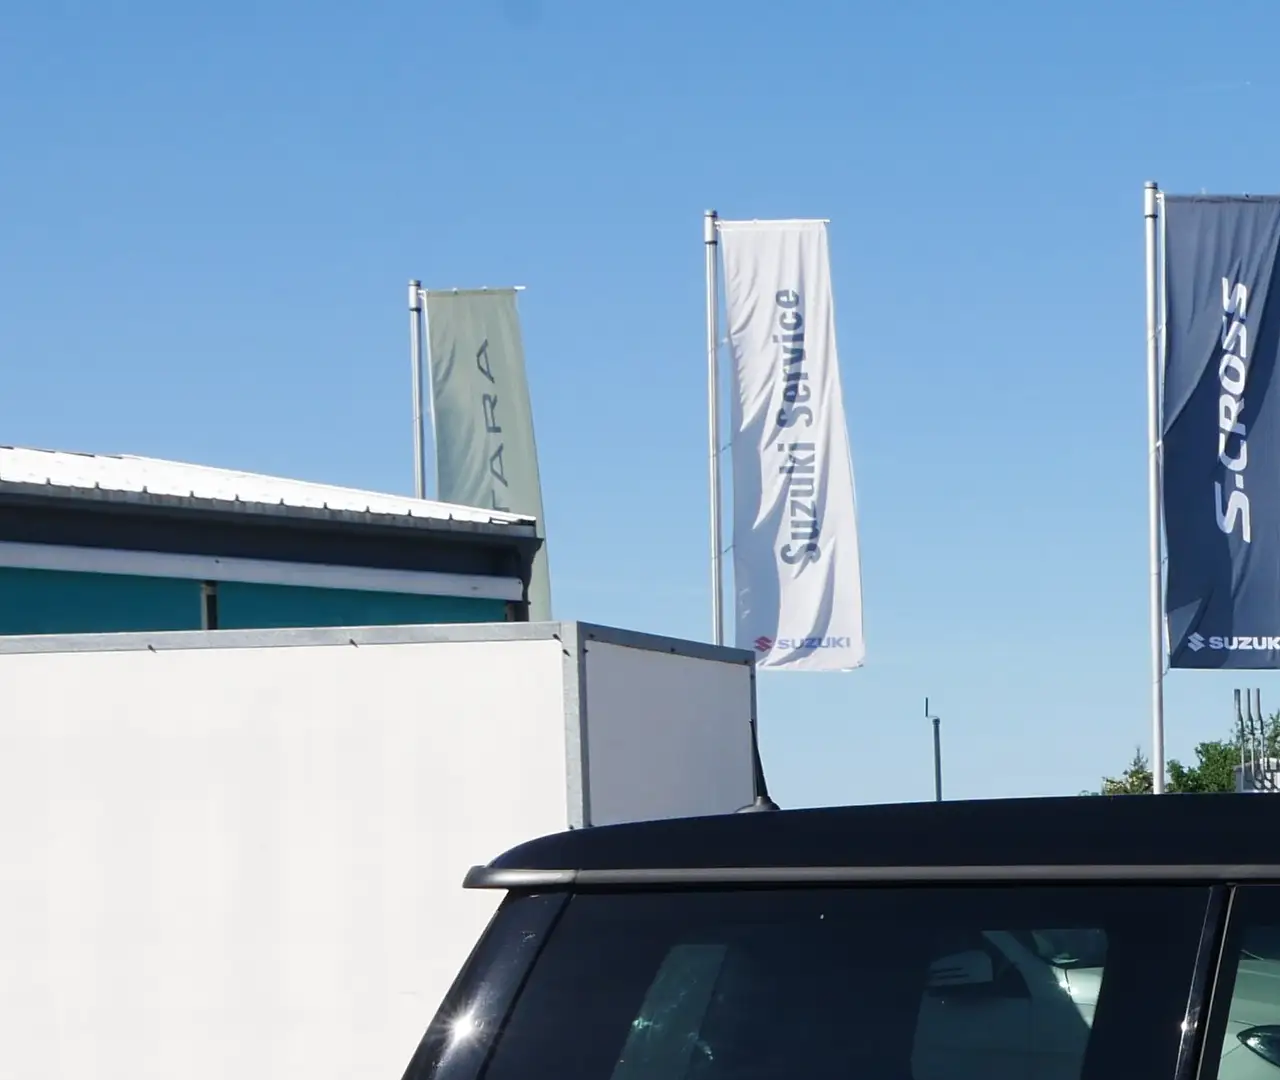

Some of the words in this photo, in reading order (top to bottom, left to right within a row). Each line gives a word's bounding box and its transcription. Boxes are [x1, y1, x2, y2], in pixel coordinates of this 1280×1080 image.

[773, 288, 813, 428] Service
[777, 442, 822, 565] Suzuki
[777, 636, 851, 649] SUZUKI
